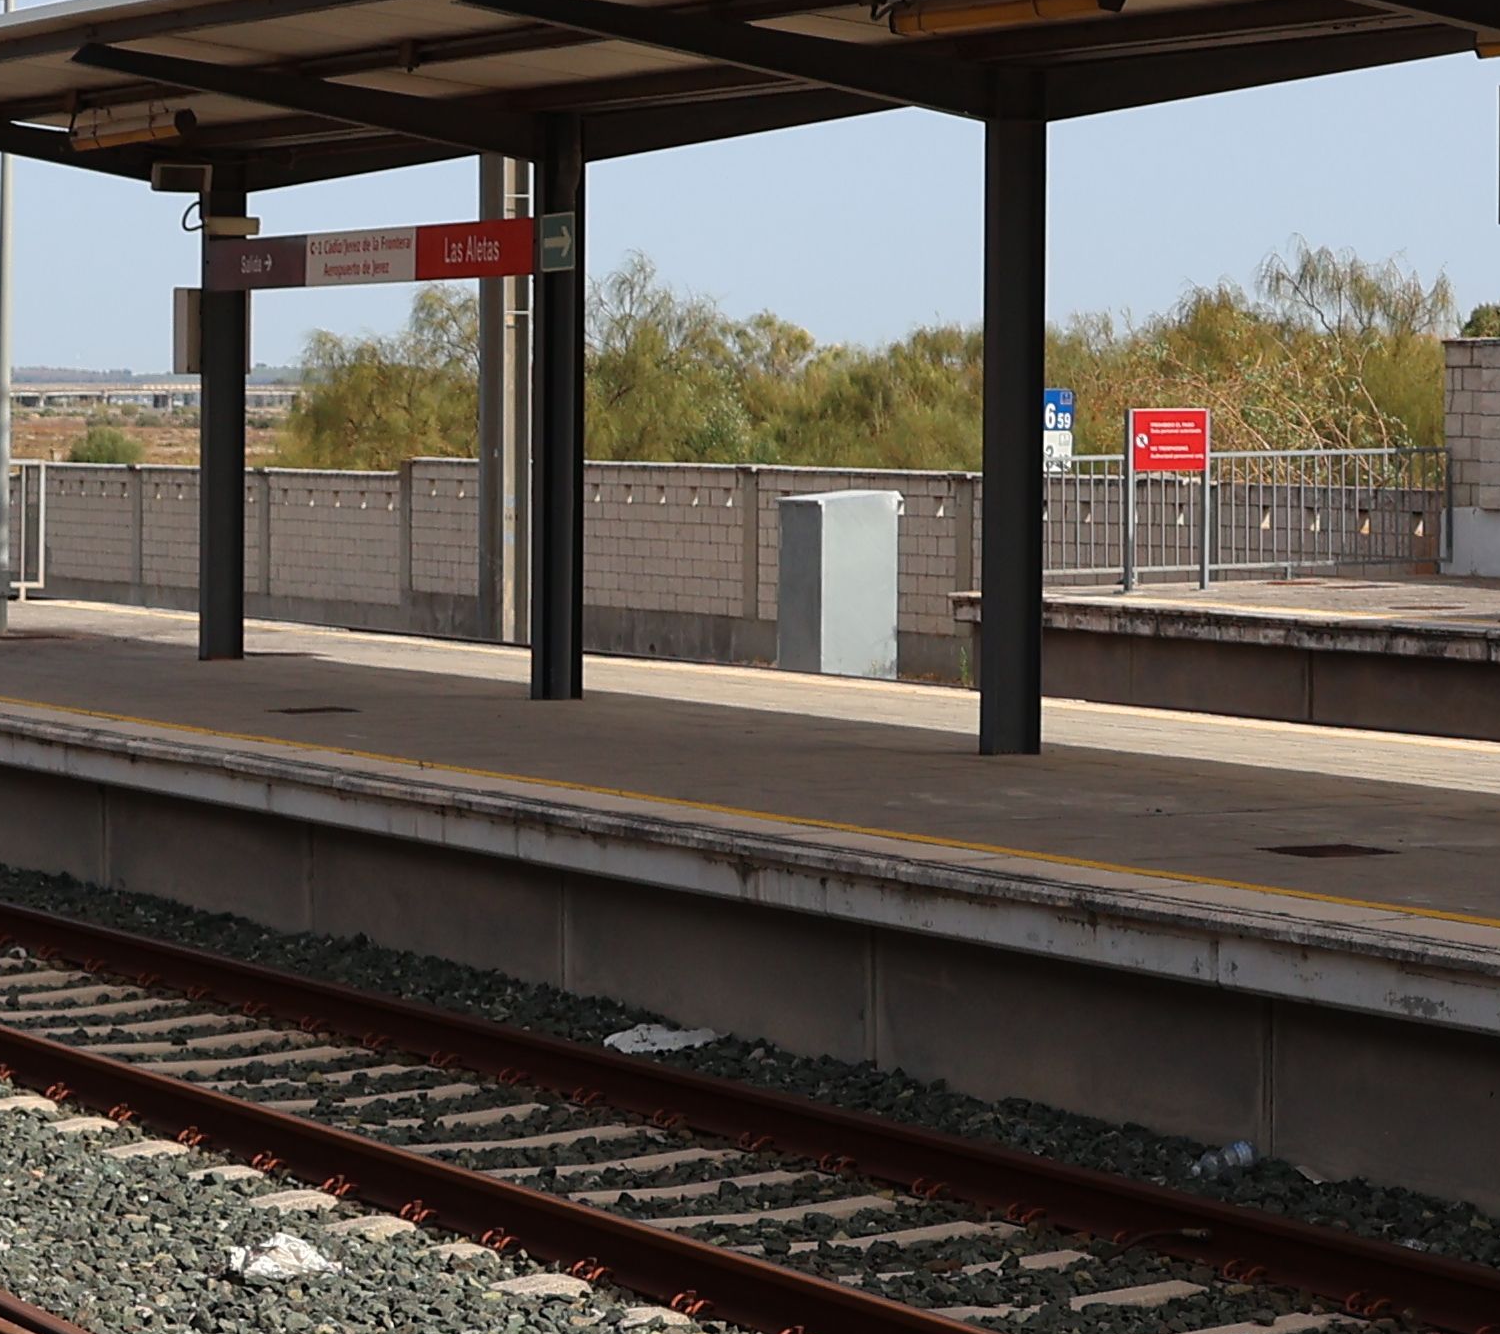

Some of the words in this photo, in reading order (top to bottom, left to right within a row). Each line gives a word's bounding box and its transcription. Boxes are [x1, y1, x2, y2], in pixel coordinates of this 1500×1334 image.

[362, 238, 371, 252] de
[372, 236, 379, 251] la
[444, 237, 463, 263] Las
[465, 235, 500, 262] Aletas
[241, 255, 262, 274] Salida
[362, 260, 371, 275] de
